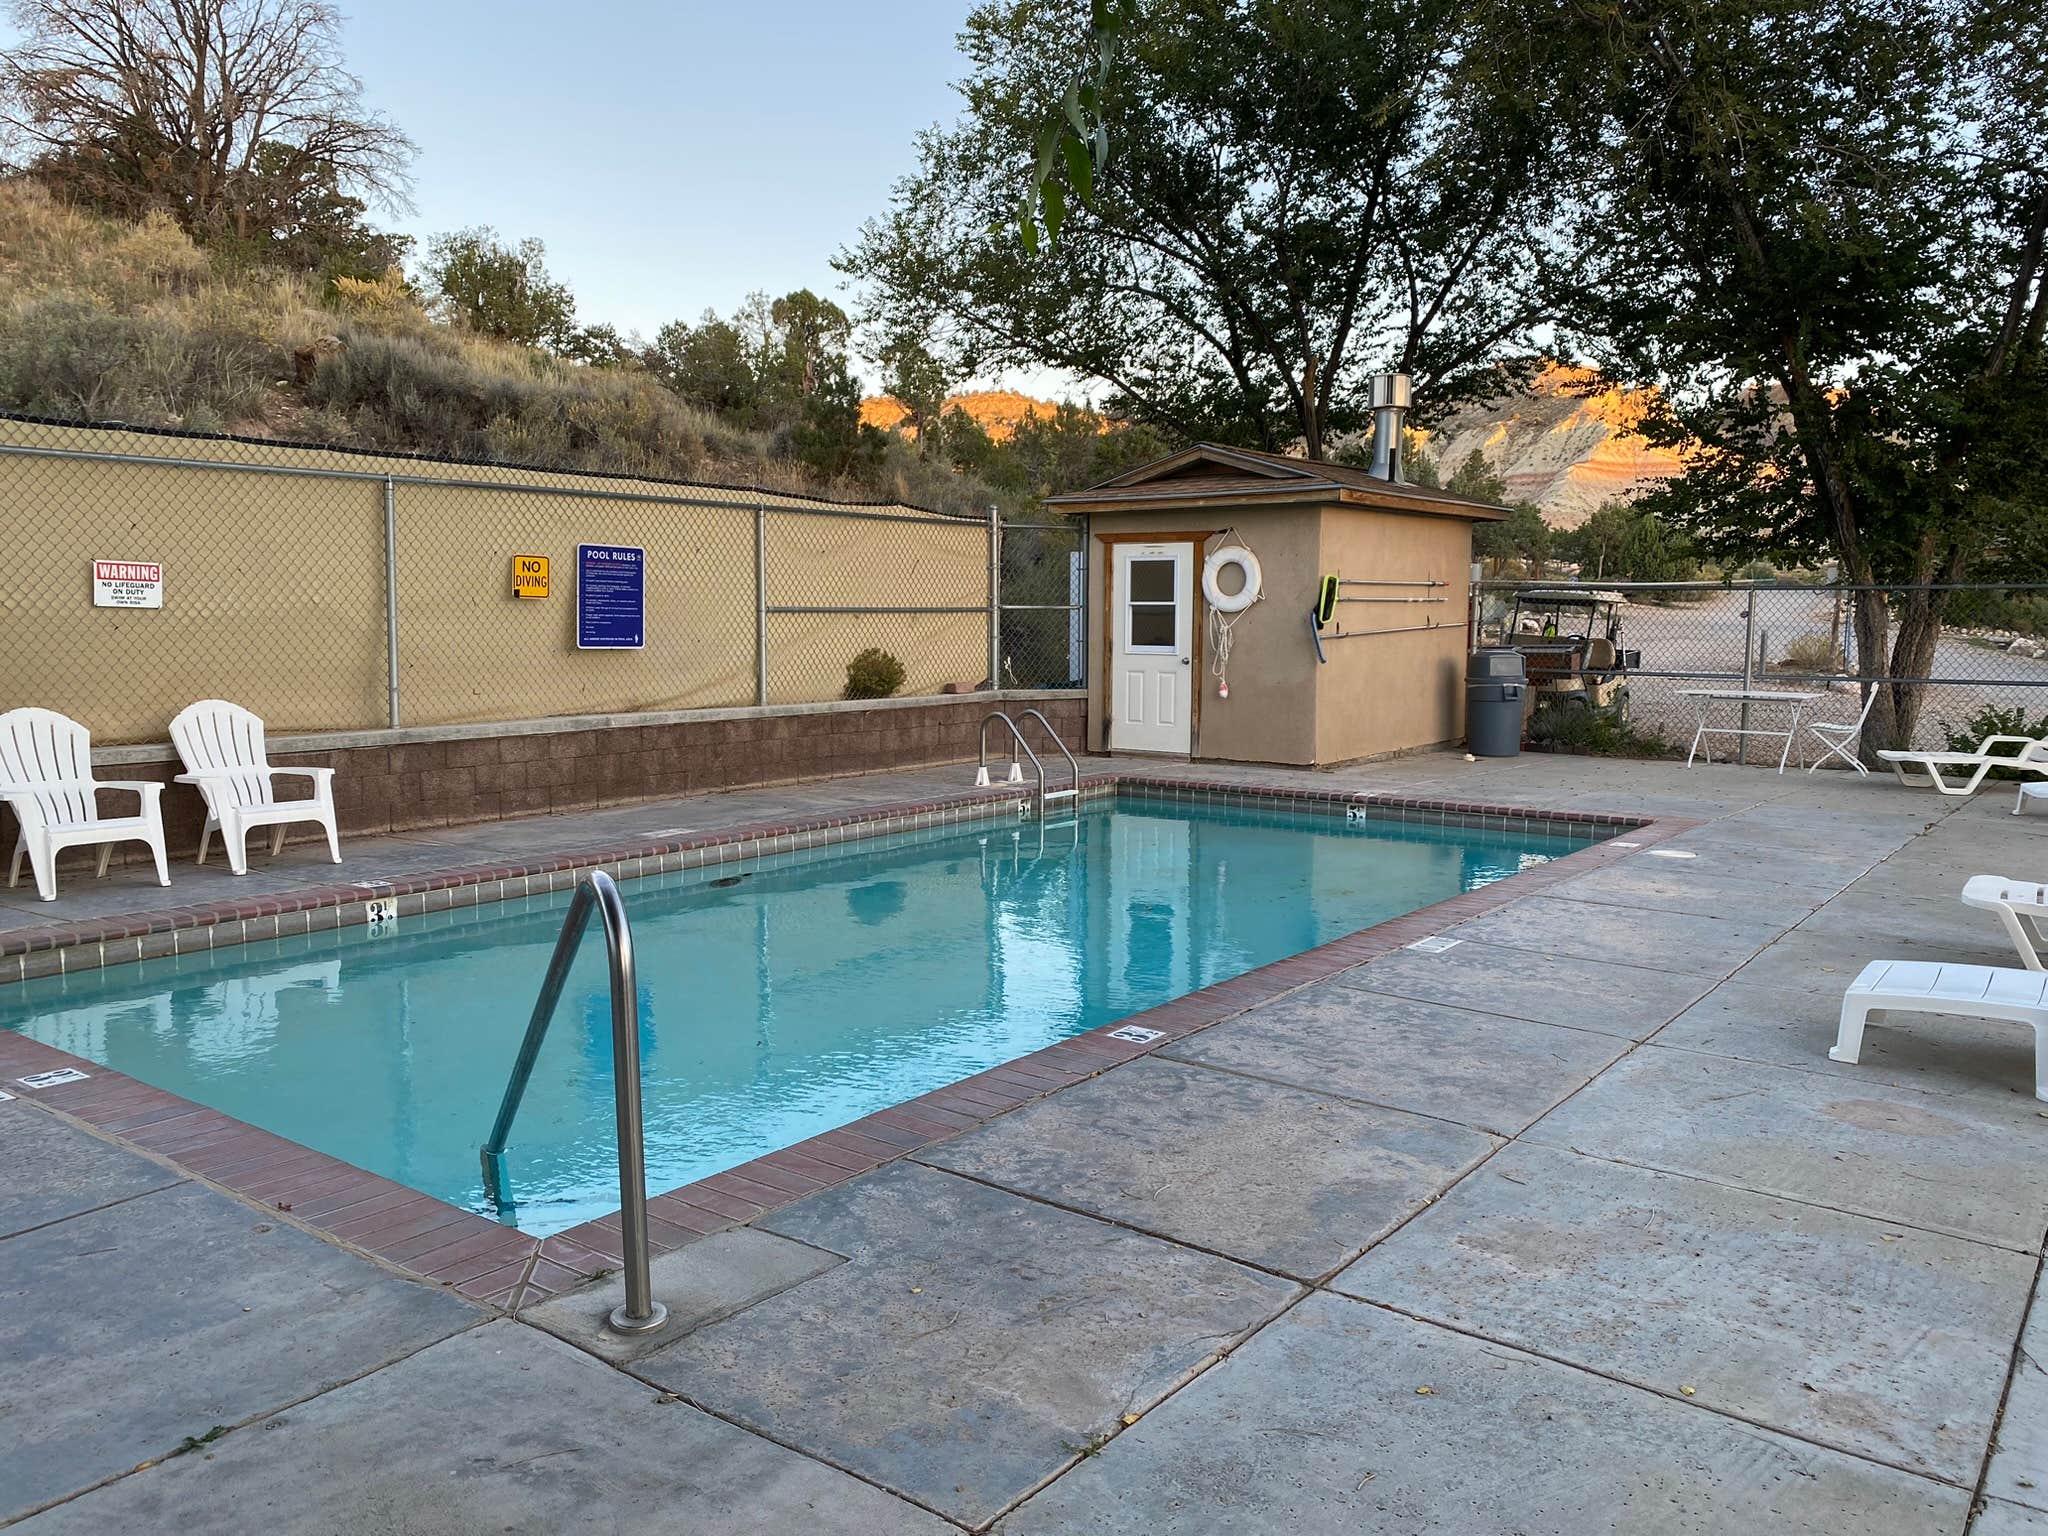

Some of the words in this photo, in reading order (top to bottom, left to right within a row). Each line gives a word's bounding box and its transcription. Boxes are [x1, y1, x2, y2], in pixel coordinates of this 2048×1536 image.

[587, 550, 610, 560] POOL
[612, 552, 636, 561] RULES
[98, 564, 158, 580] WARNING
[522, 560, 541, 573] NO
[515, 574, 547, 588] DIVING
